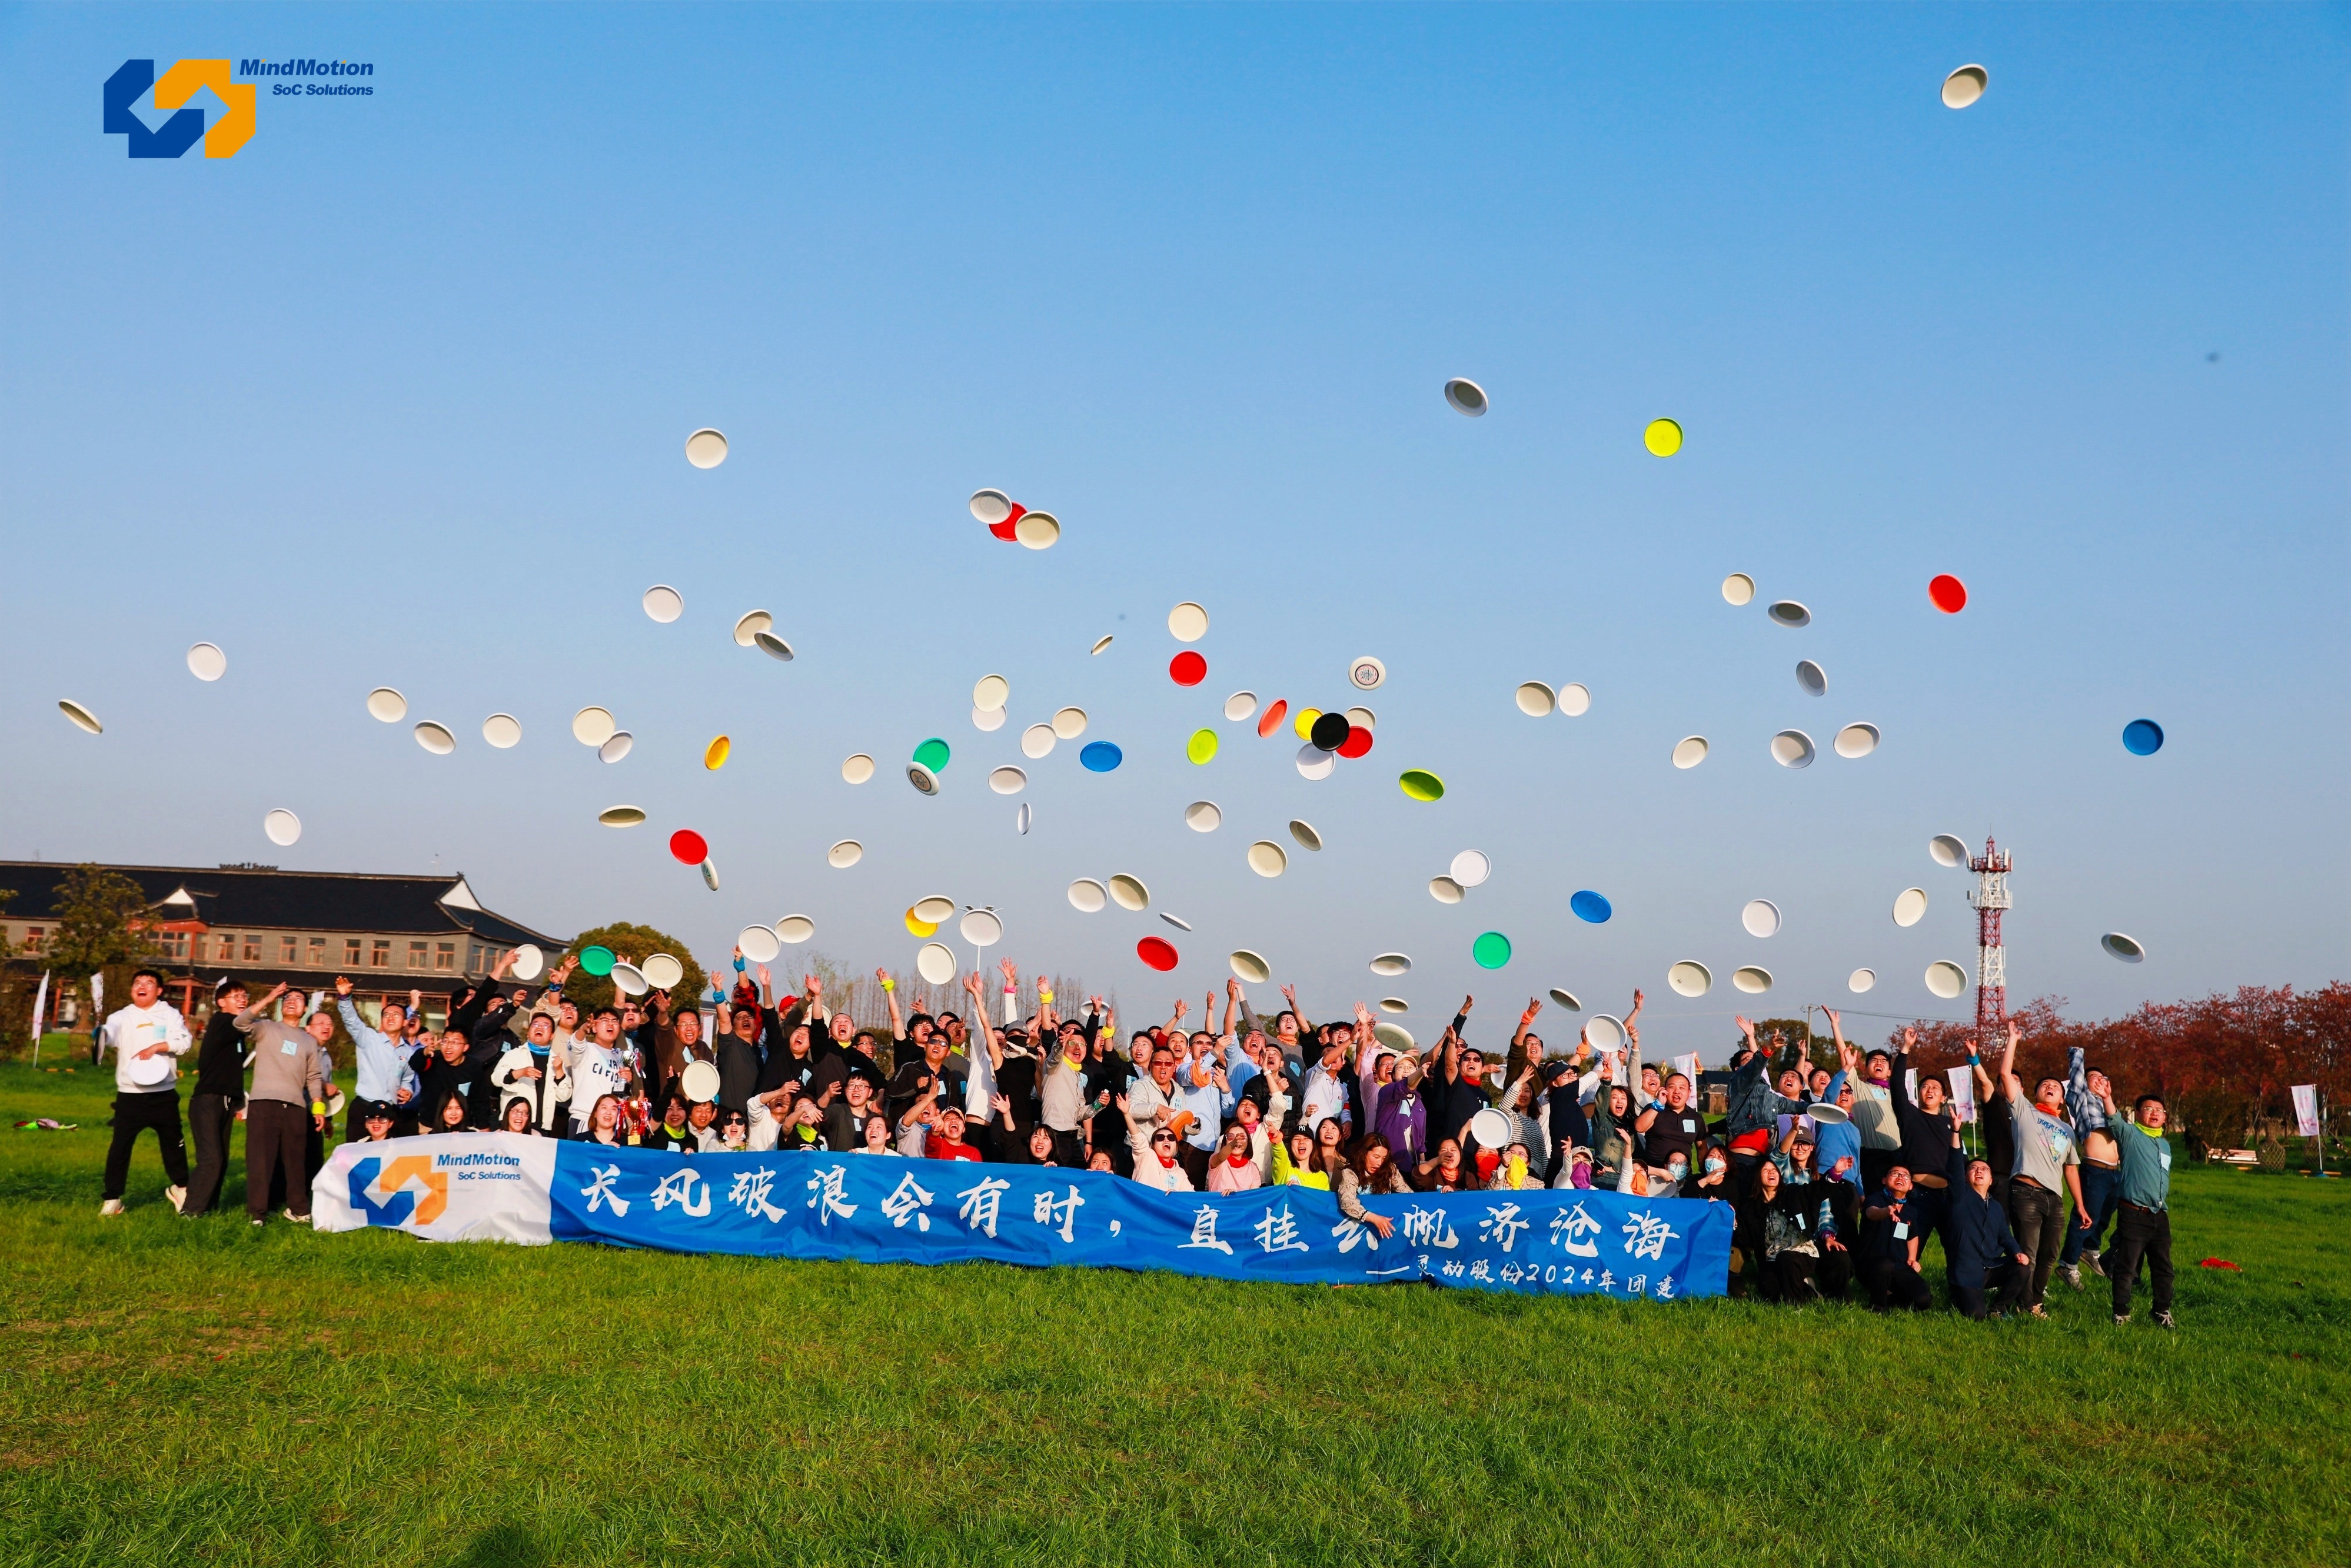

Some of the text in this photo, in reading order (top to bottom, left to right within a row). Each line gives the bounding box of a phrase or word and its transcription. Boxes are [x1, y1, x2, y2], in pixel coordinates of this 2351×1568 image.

[437, 1154, 520, 1166] MindMotion
[458, 1171, 521, 1180] SoC Solutions
